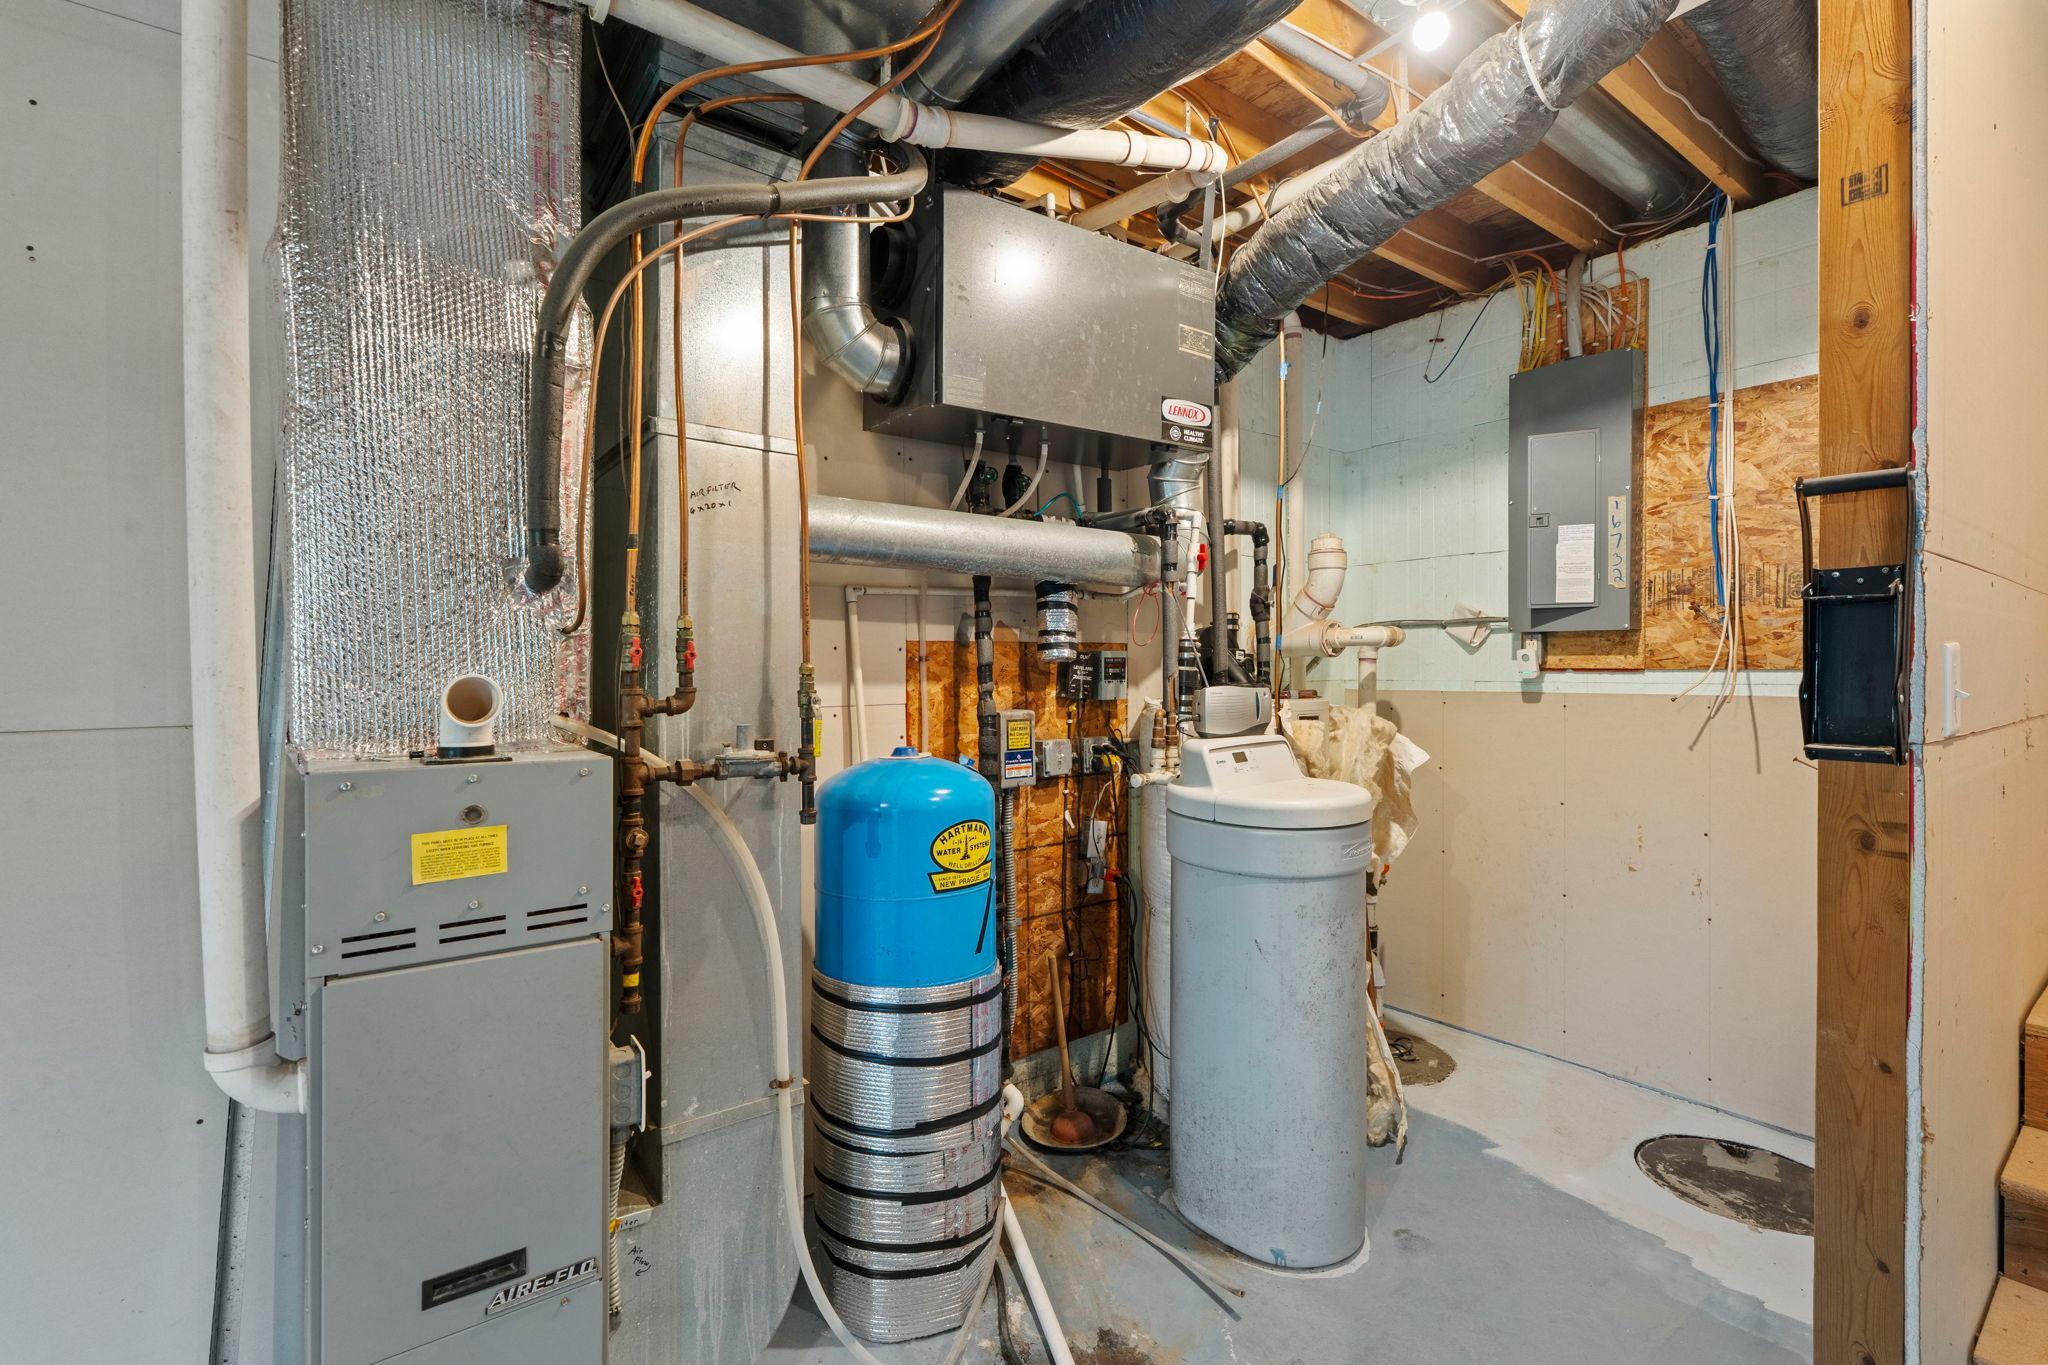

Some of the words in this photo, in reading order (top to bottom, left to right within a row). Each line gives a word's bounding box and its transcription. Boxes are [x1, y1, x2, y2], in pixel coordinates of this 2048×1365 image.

[1168, 405, 1199, 420] LENNOX
[1183, 429, 1205, 438] HEALTHY
[690, 488, 706, 500] AIR
[706, 481, 742, 495] FILTER
[939, 823, 988, 846] HARTMANN
[936, 847, 962, 857] WATER
[969, 839, 990, 852] SYSTEMS
[948, 861, 963, 869] WELL
[939, 880, 956, 889] NEW
[959, 874, 980, 886] PRAGUE
[628, 1245, 643, 1255] Air
[633, 1256, 649, 1266] Flow
[487, 1257, 598, 1309] AIRE-FLO
